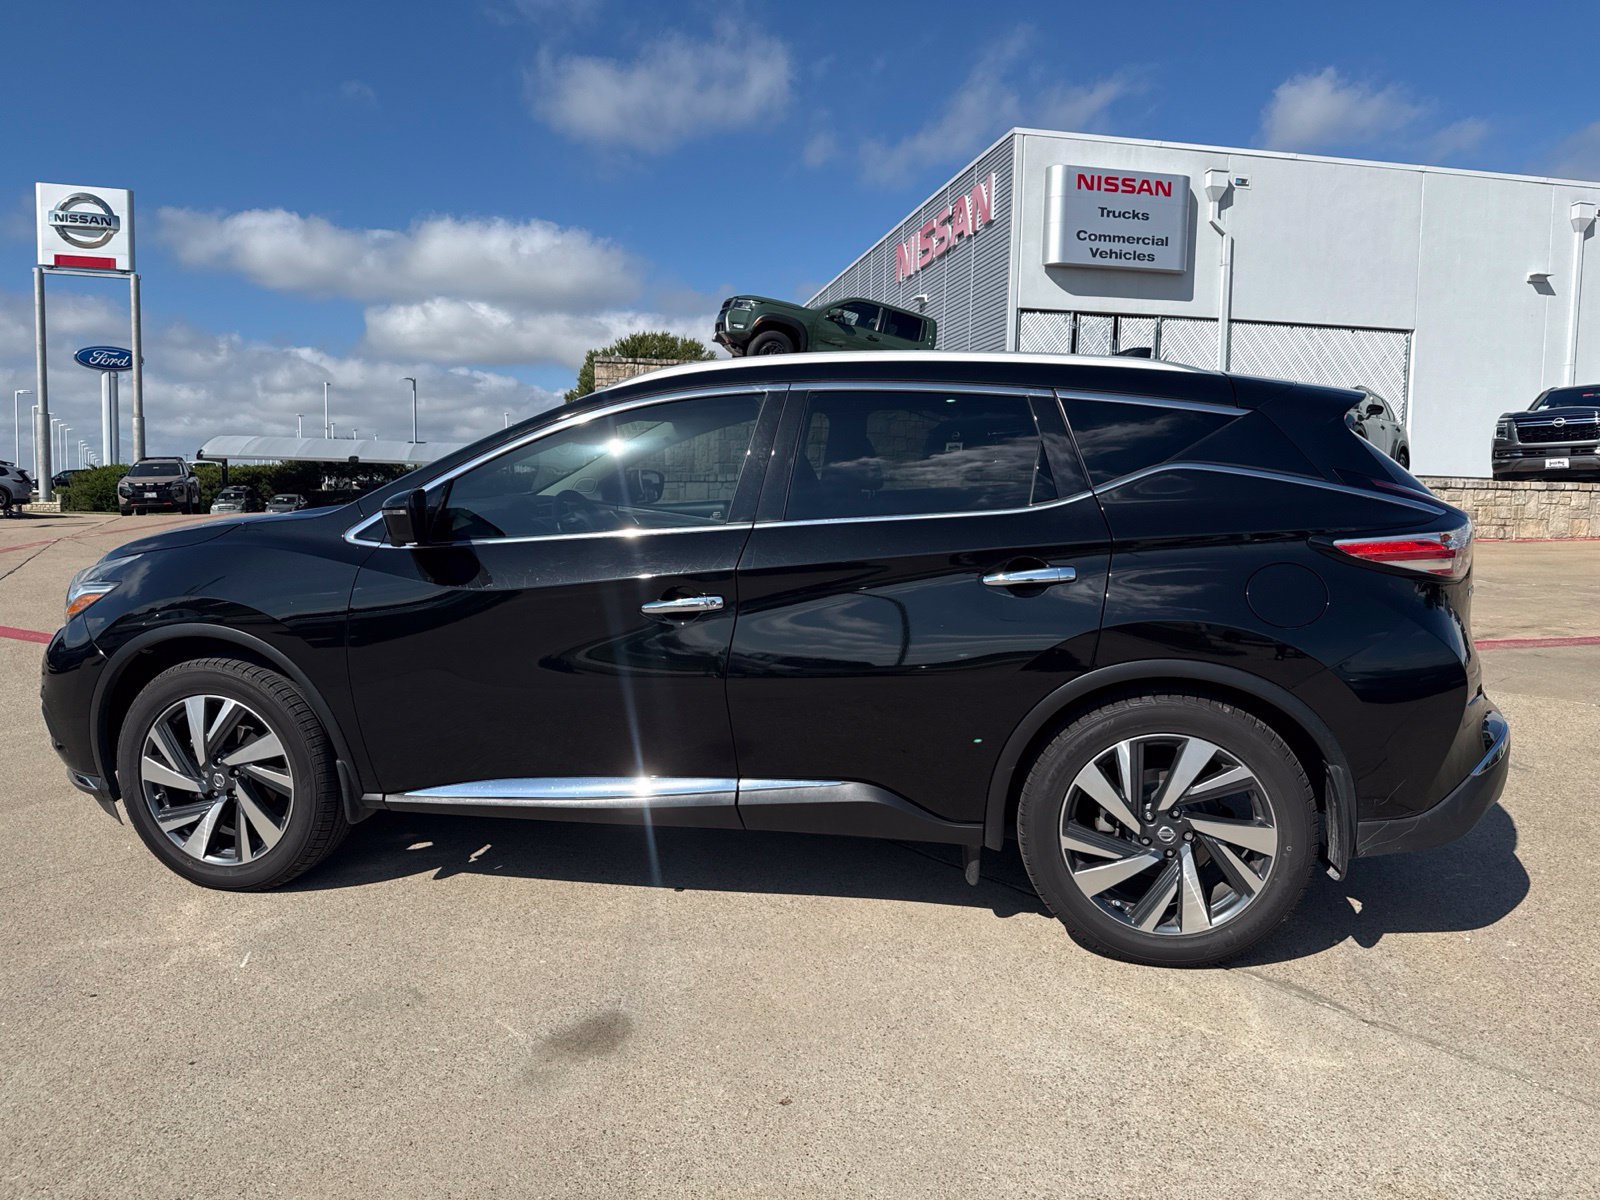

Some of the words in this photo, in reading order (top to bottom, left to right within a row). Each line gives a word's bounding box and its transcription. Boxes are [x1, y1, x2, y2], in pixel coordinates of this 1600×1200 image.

[1076, 173, 1172, 197] NISSAN
[54, 213, 112, 227] NISSAN
[1098, 206, 1150, 221] Trucks
[895, 172, 997, 284] NISSAN
[1076, 229, 1169, 247] Commercial
[1089, 247, 1156, 262] Vehicles
[89, 350, 130, 366] Ford
